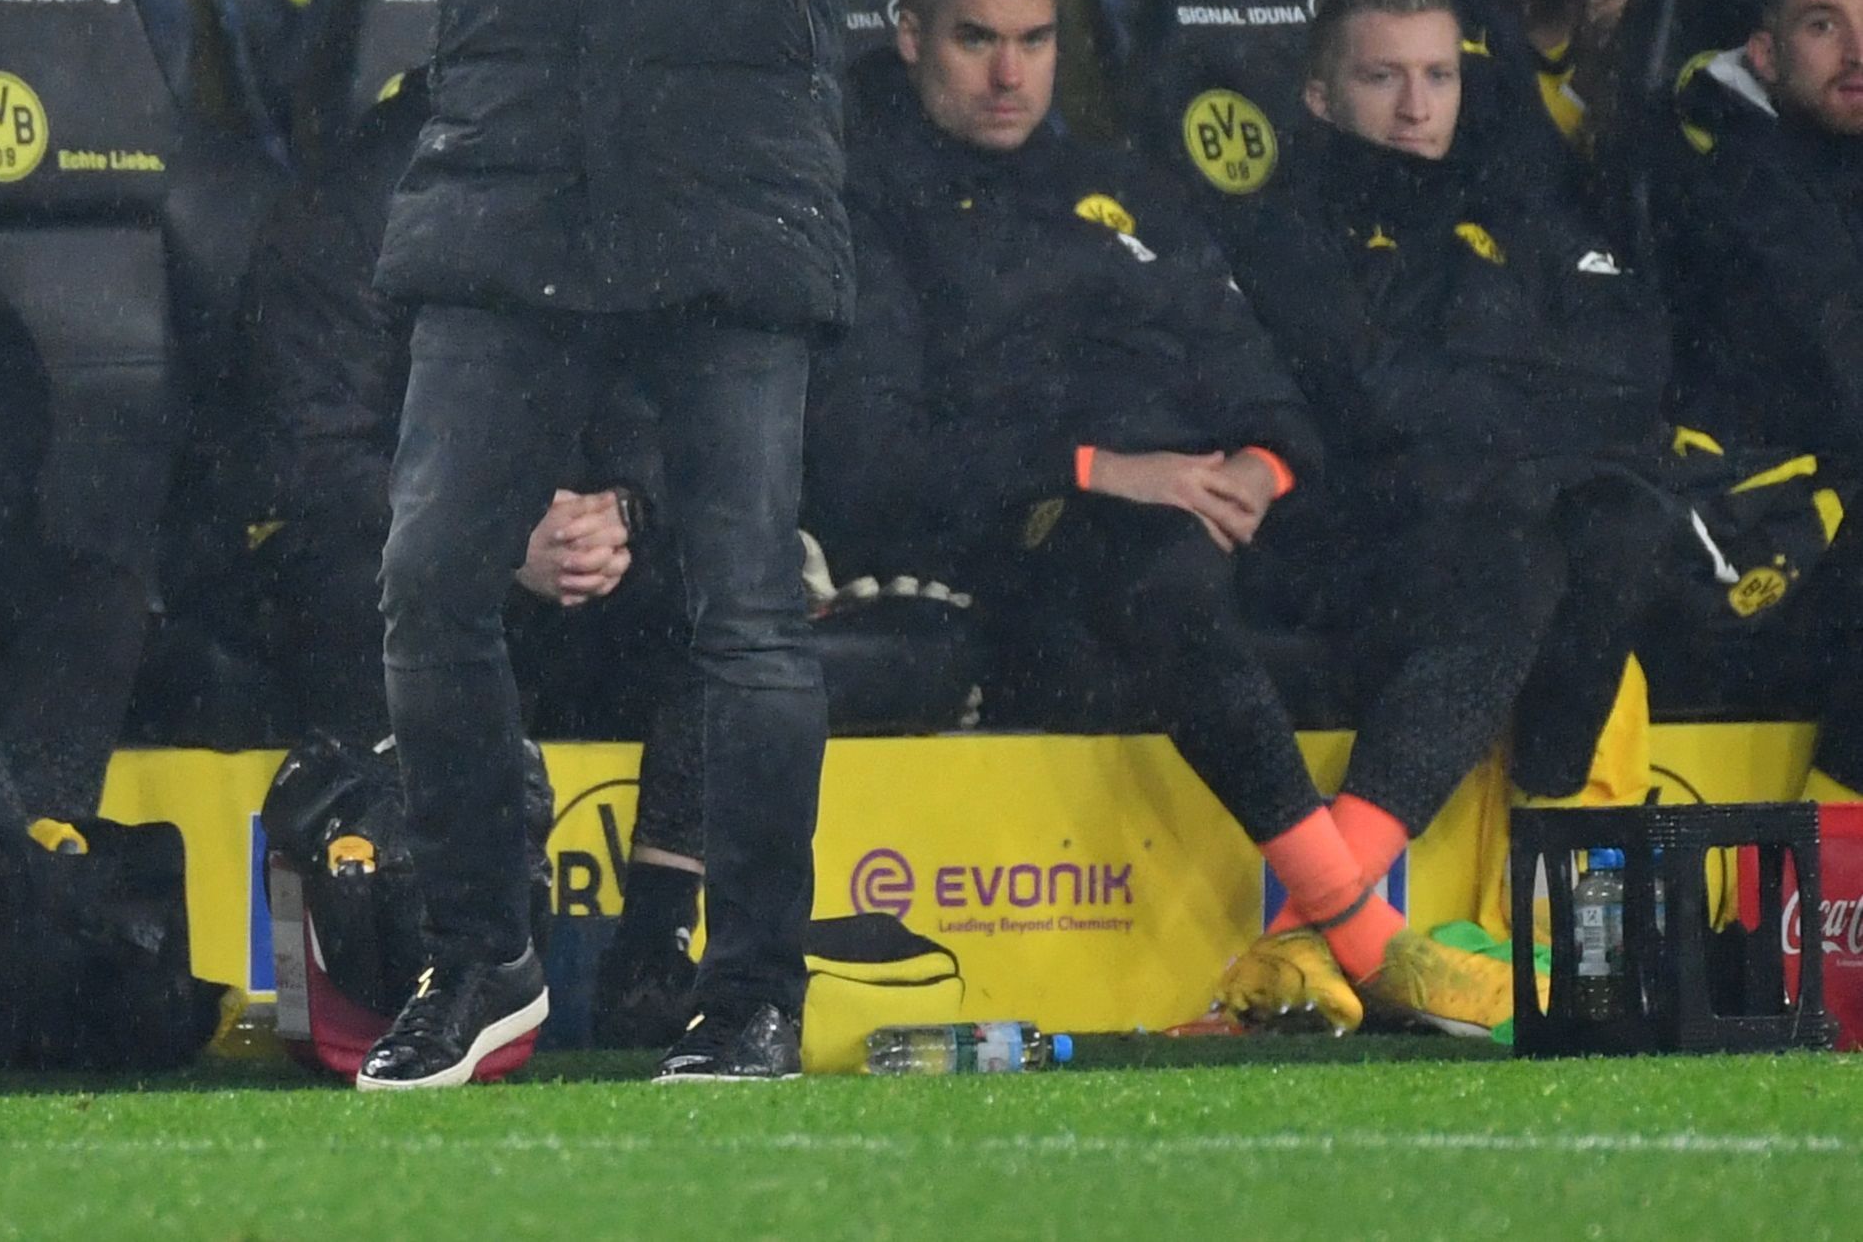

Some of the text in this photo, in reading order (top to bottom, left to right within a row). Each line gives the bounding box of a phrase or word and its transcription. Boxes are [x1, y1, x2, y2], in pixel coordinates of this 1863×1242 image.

[1177, 6, 1306, 26] SIGNAL IDUNA
[1198, 102, 1267, 161] BVB
[935, 862, 1134, 908] EVONIK
